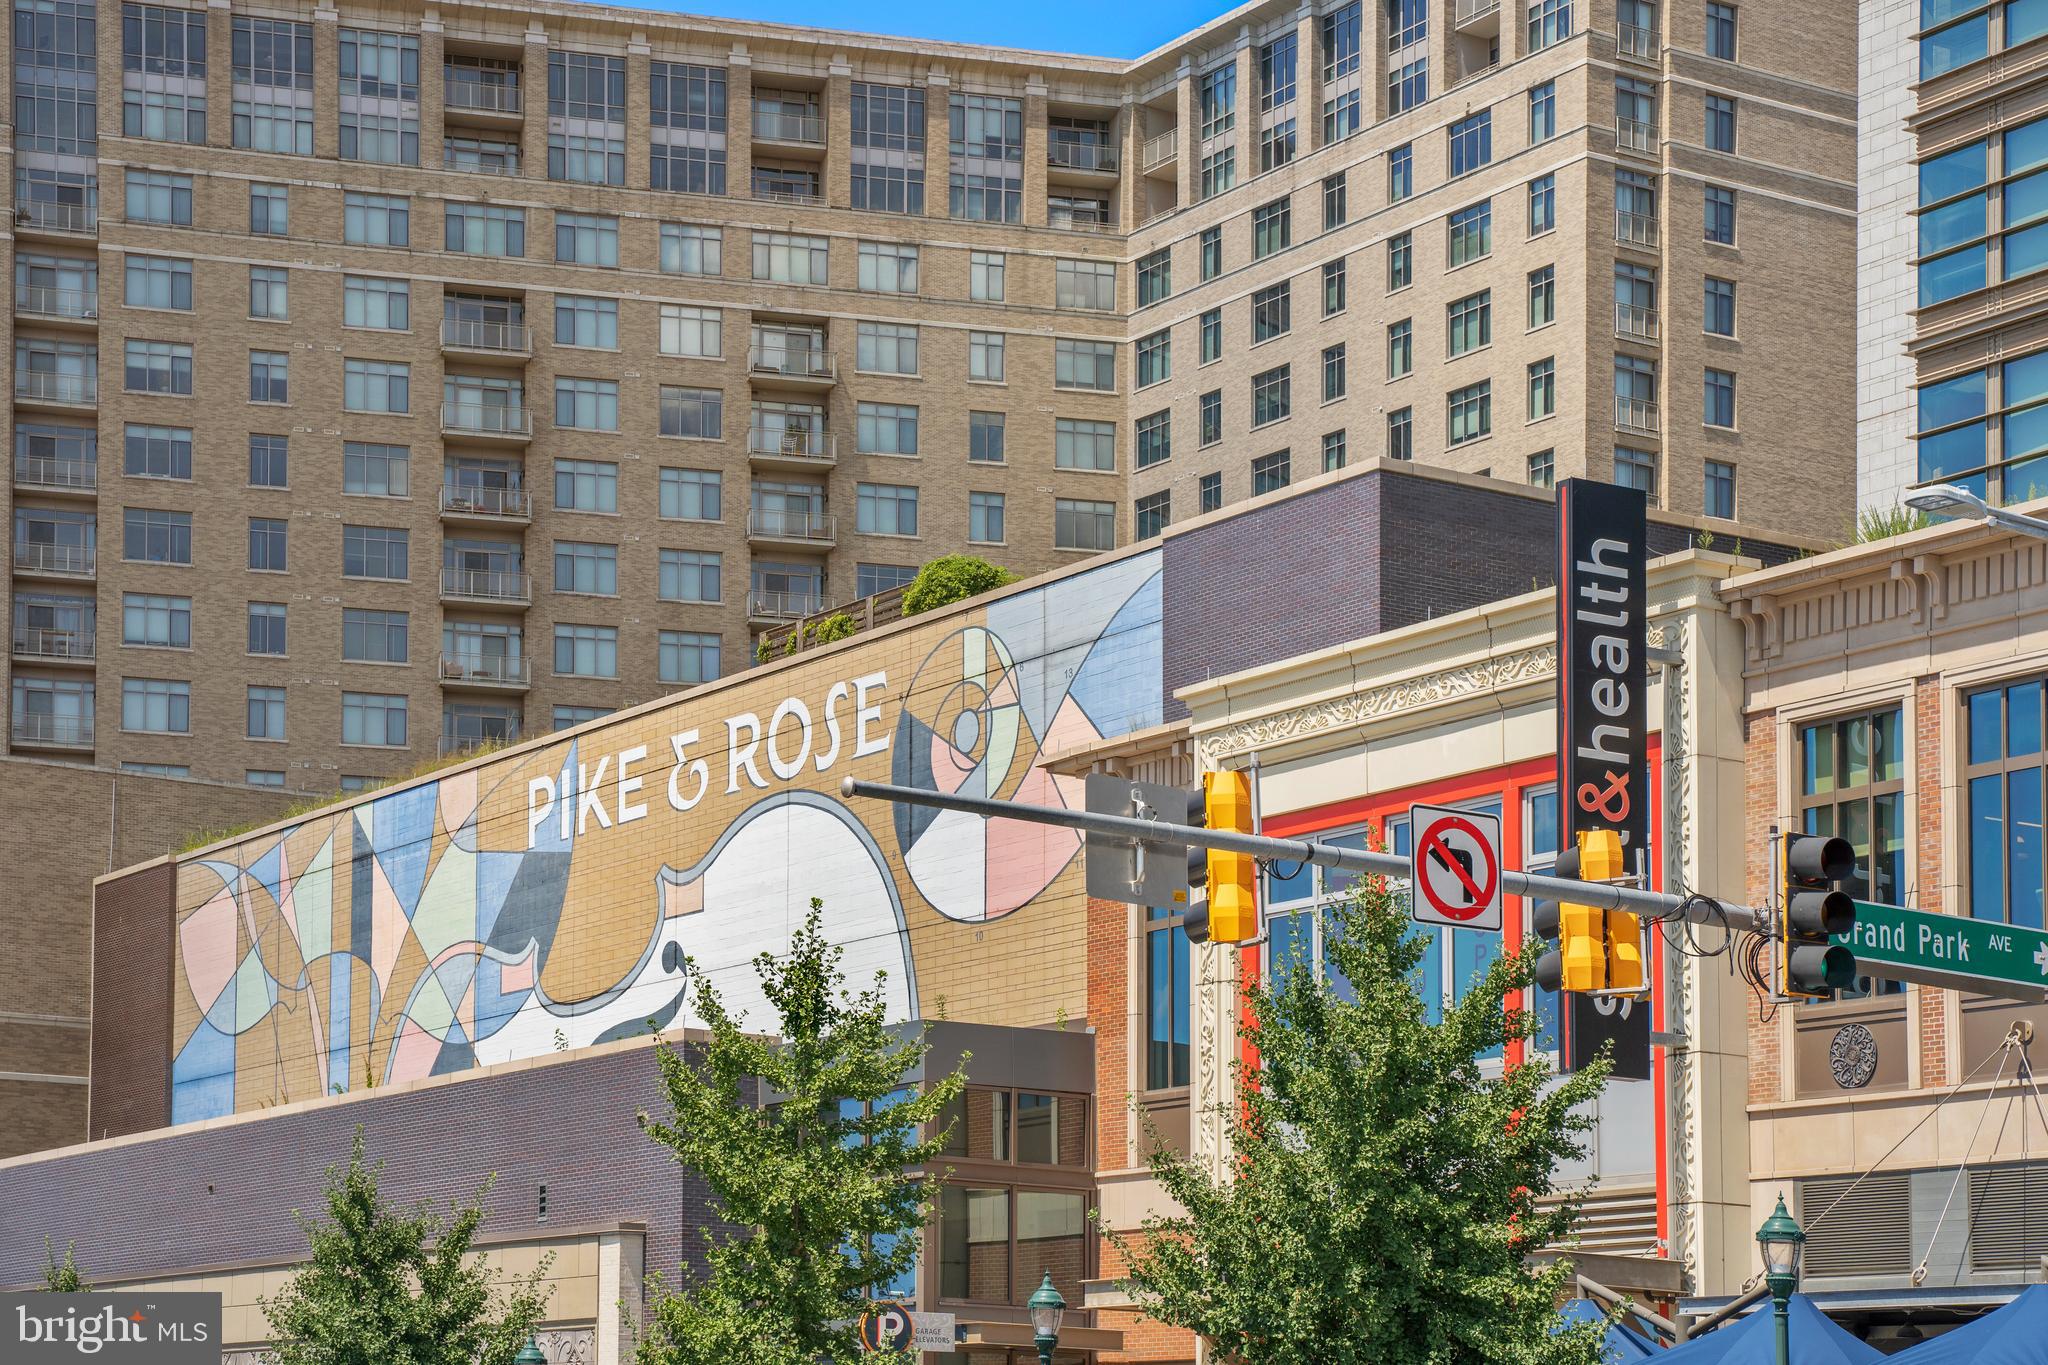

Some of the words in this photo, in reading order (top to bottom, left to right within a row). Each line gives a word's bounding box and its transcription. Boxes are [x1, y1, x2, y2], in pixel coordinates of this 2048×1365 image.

[1577, 538, 1630, 764] health
[528, 745, 648, 849] PIKE
[667, 728, 709, 811] &
[724, 670, 892, 794] ROSE
[1577, 770, 1630, 823] &
[1918, 924, 1970, 962] Park
[1988, 934, 2013, 953] AVE
[877, 1311, 904, 1352] P
[915, 1327, 942, 1336] GARAGE
[915, 1336, 951, 1345] ELEVATORS
